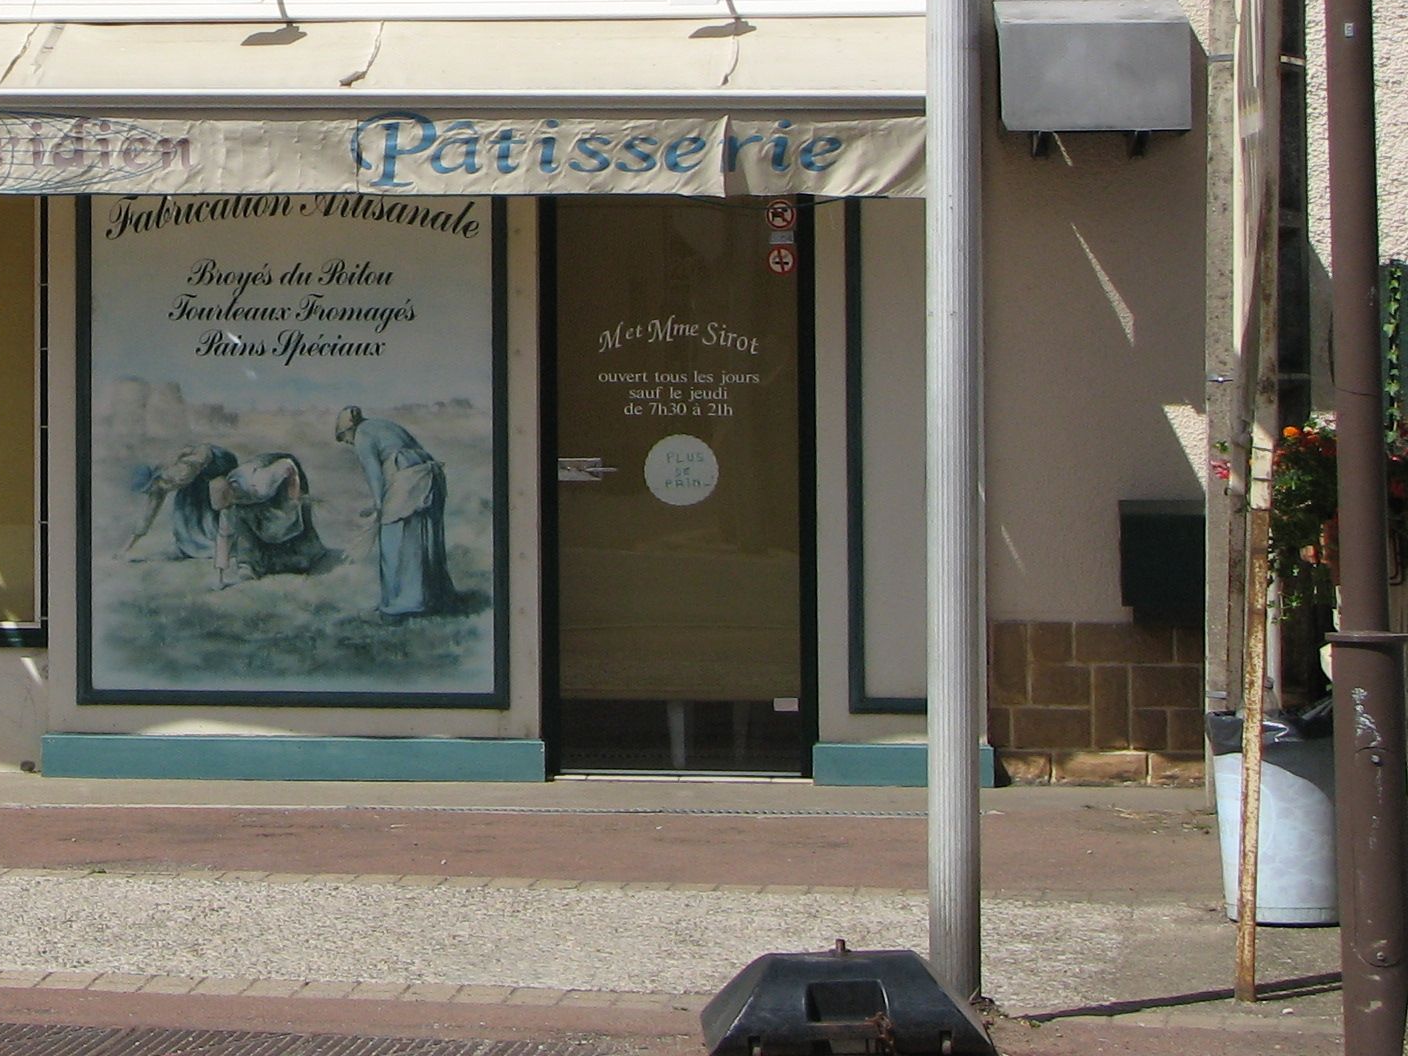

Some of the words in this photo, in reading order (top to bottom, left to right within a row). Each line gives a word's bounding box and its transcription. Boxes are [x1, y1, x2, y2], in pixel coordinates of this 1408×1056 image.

[350, 110, 845, 189] Pâtisserie
[186, 257, 273, 298] Broyés
[279, 258, 310, 287] du
[317, 258, 395, 287] Poitou
[167, 293, 292, 322] Tourteaux
[294, 293, 417, 333] Fromagés
[195, 330, 266, 357] Pains
[271, 329, 386, 366] Spéciaux
[599, 322, 624, 352] M
[625, 326, 643, 341] et
[648, 315, 699, 343] Mme
[702, 322, 760, 355] Sirot
[598, 371, 648, 383] ouvert
[655, 371, 688, 383] tous
[694, 370, 714, 383] les
[719, 370, 760, 385] jours
[629, 386, 662, 399] sauf
[670, 387, 682, 399] le
[689, 386, 728, 402] jeudi
[624, 403, 642, 416] de
[650, 402, 687, 416] 7h30
[707, 402, 733, 416] 21h
